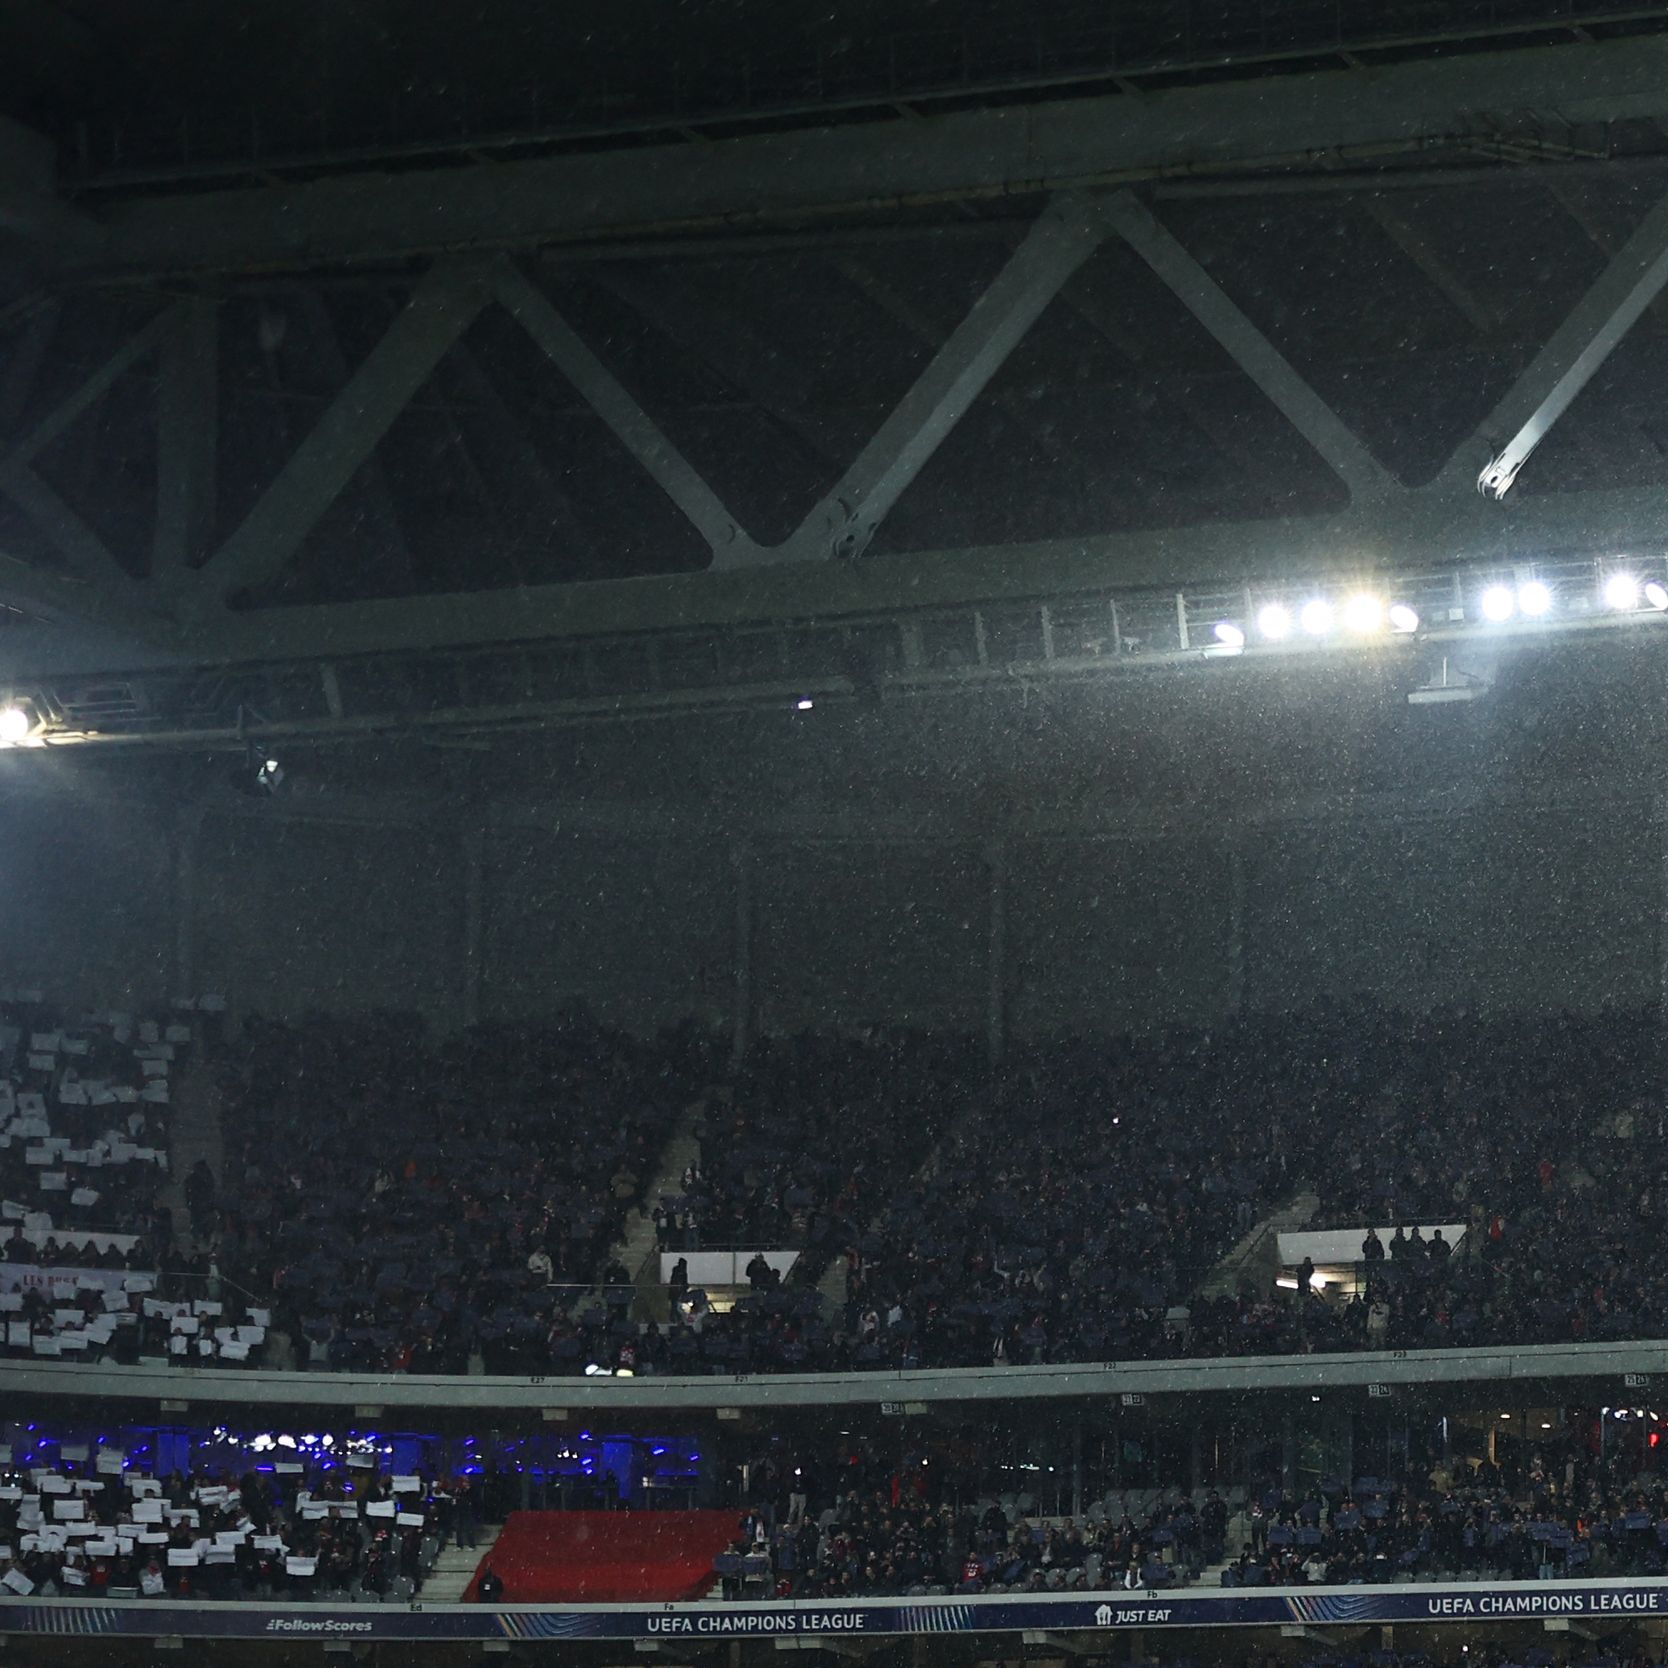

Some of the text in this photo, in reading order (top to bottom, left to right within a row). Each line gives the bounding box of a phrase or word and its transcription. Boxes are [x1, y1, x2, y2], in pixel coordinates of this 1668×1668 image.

[1147, 1591, 1158, 1599] Fb
[664, 1602, 674, 1610] Fa
[1428, 1593, 1659, 1613] UEFA CHAMPIONS LEAGUE
[648, 1614, 864, 1632] UEFA CHAMPIONS LEAGUE
[1115, 1609, 1172, 1624] JUST EAT
[274, 1619, 373, 1631] FollowScores
